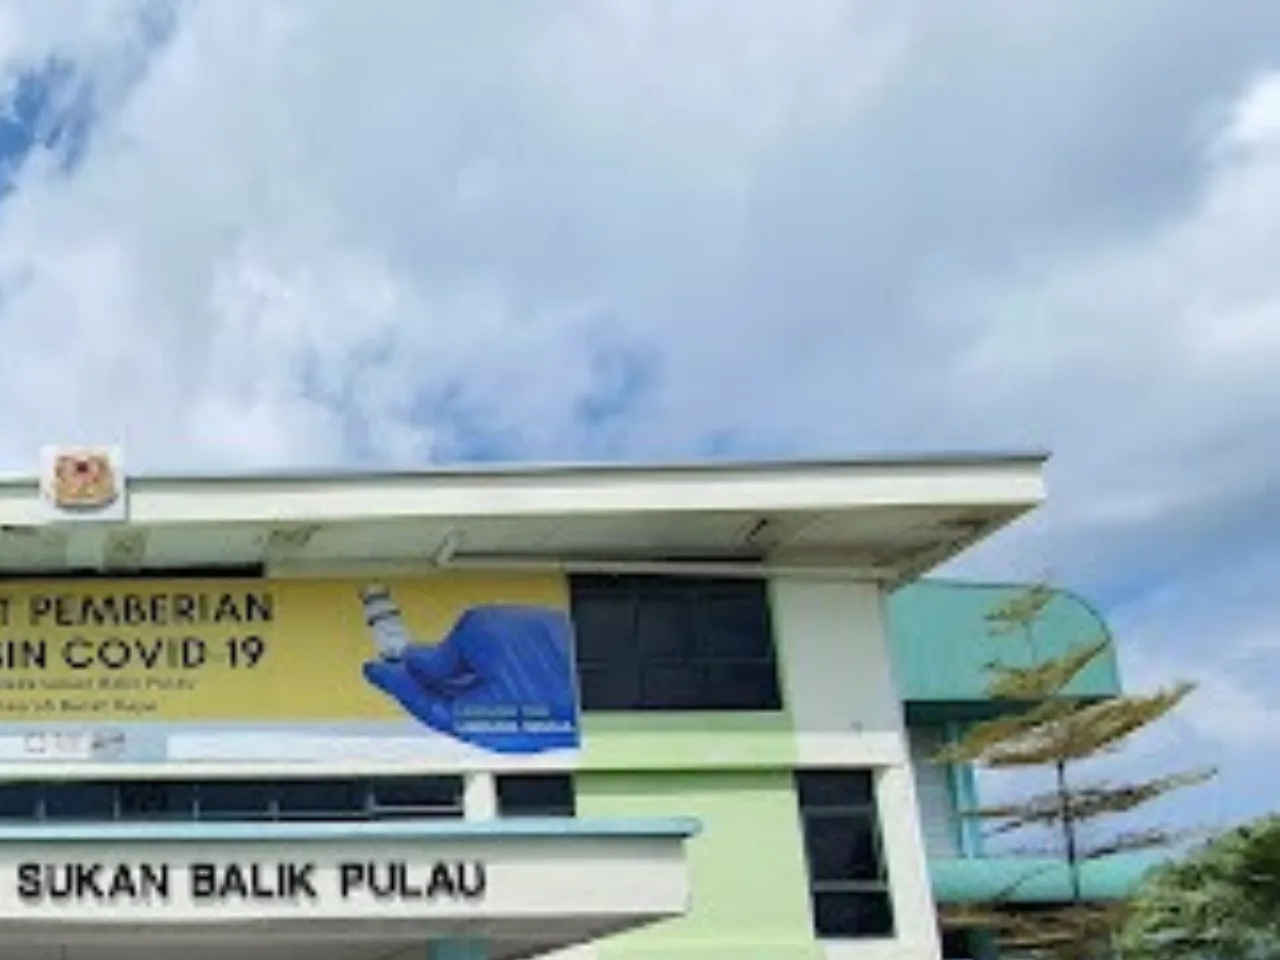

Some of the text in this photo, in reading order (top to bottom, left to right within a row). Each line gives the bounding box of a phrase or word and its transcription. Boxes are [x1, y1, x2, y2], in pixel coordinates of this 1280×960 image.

[29, 592, 275, 627] PEMBERIAN
[17, 863, 170, 901] SUKAN
[192, 862, 318, 900] BALIK
[339, 861, 489, 899] PULAU
